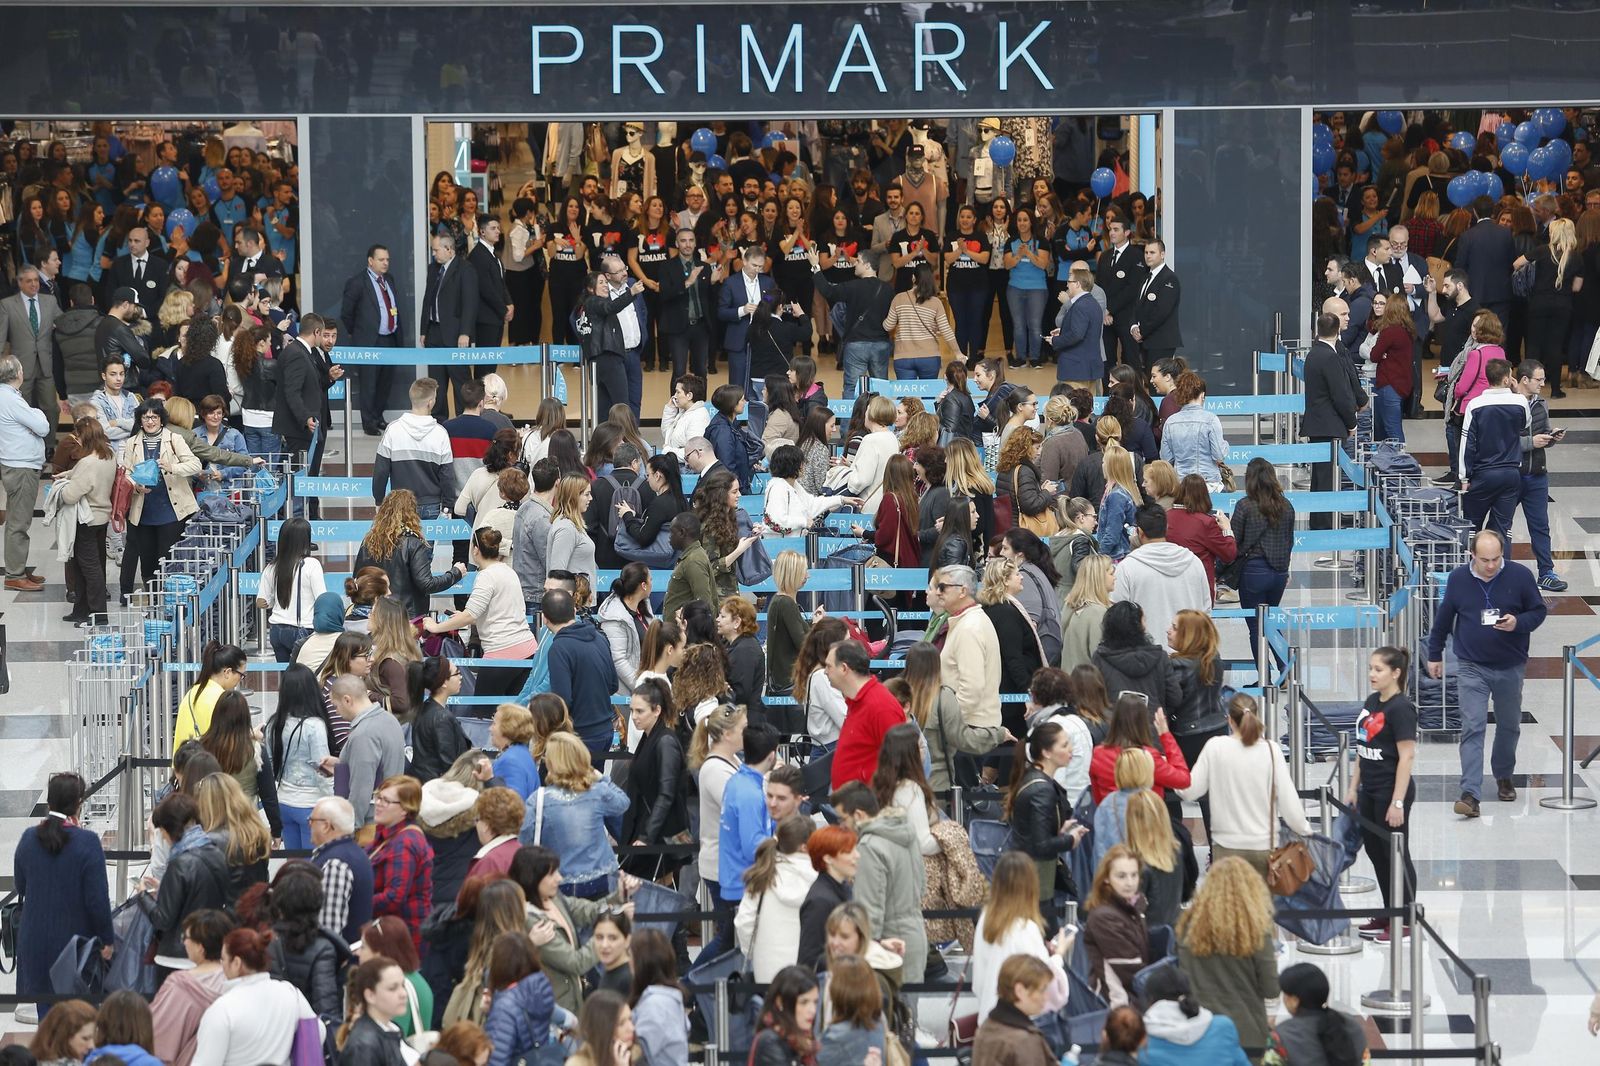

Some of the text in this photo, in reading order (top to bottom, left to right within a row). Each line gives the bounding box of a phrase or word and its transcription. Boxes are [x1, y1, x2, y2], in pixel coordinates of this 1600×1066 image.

[531, 21, 1055, 94] PRIMARK
[639, 253, 667, 262] PRIMARK
[451, 351, 504, 361] PRIMARK
[298, 482, 359, 491] PRIMARK
[426, 525, 469, 534] PRIMA
[1268, 612, 1337, 625] PRMARK
